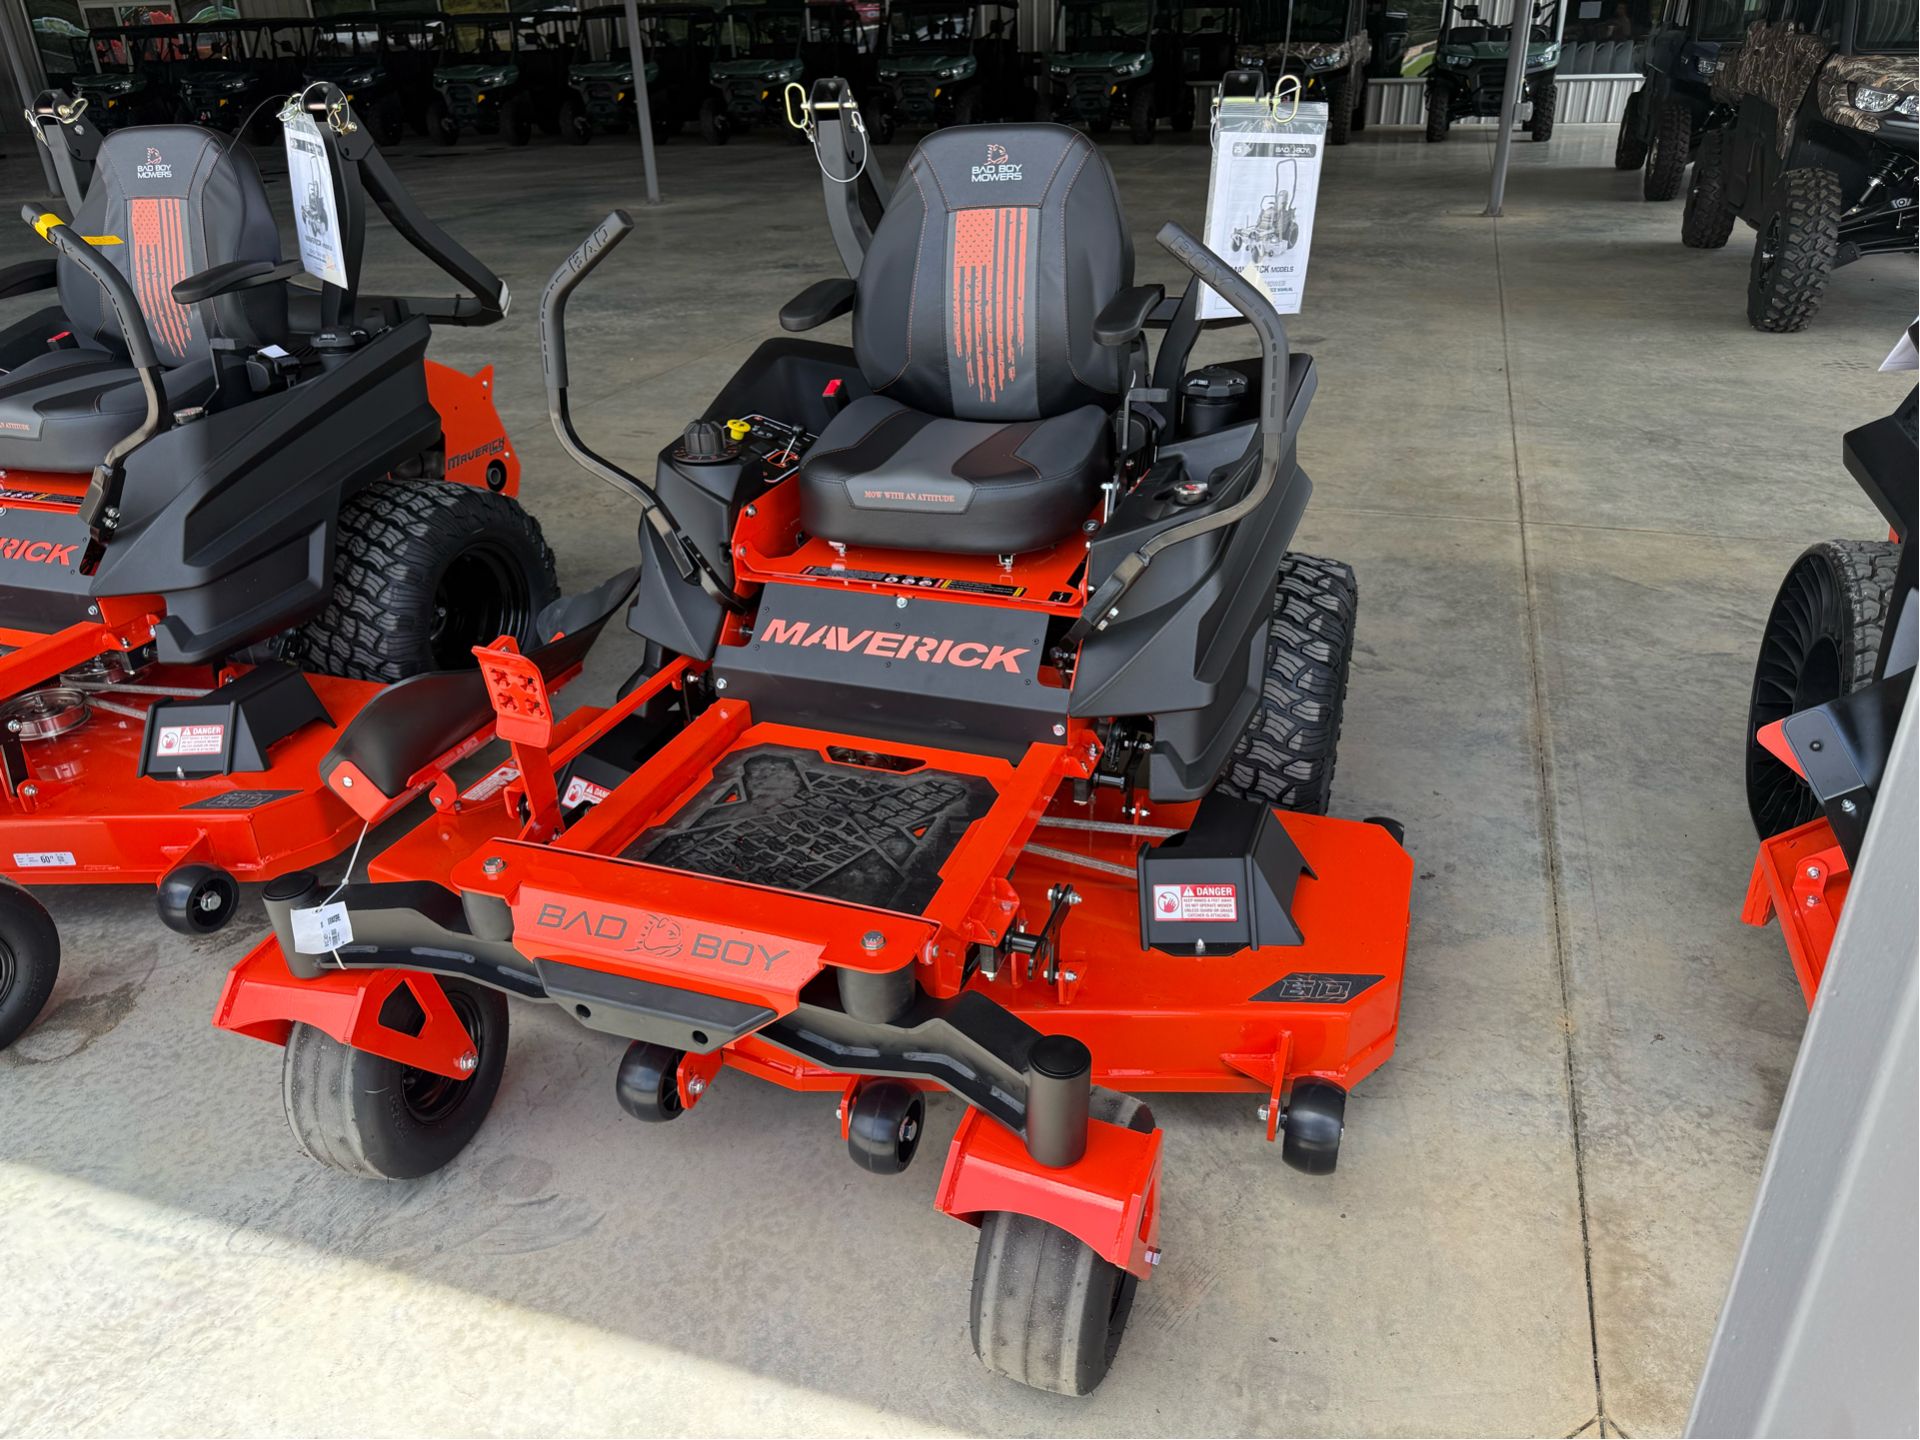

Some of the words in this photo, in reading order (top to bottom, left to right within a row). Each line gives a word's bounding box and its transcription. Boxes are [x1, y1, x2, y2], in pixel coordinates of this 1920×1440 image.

[155, 164, 171, 172] BOY
[971, 166, 996, 174] BAD
[998, 164, 1022, 173] BOY
[137, 171, 173, 179] MOWERS
[971, 172, 1023, 182] MOWERS
[447, 436, 505, 471] MAVERICK
[864, 490, 882, 498] MOW
[883, 491, 905, 500] WITH
[905, 492, 917, 500] AN
[918, 493, 956, 503] ATTITUDE
[0, 536, 79, 567] RICK
[760, 618, 1031, 675] MAVERICK
[192, 727, 221, 736] DANGER
[1196, 886, 1233, 897] DANGER
[537, 903, 627, 941] BAD
[690, 933, 790, 972] BOY
